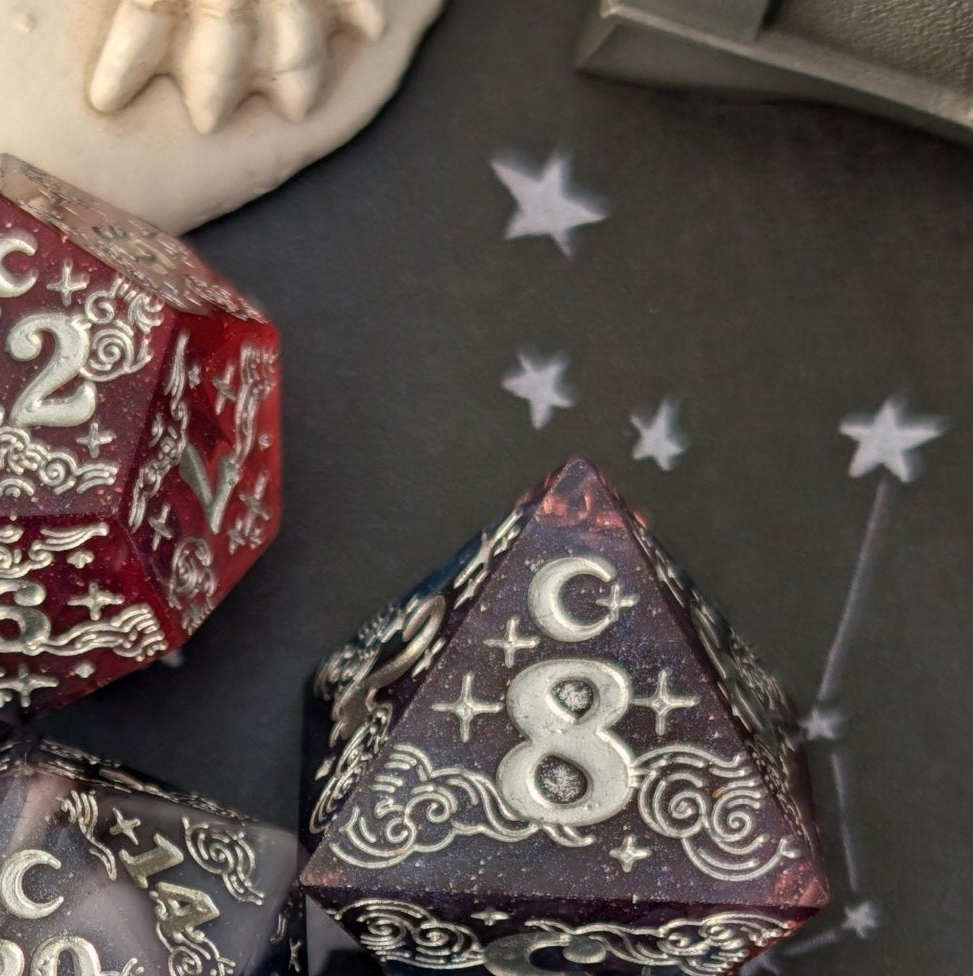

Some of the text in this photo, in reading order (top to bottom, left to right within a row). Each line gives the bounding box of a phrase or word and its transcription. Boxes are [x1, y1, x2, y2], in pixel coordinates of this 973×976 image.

[179, 442, 241, 535] 7
[497, 657, 631, 827] 8
[119, 833, 220, 942] 14
